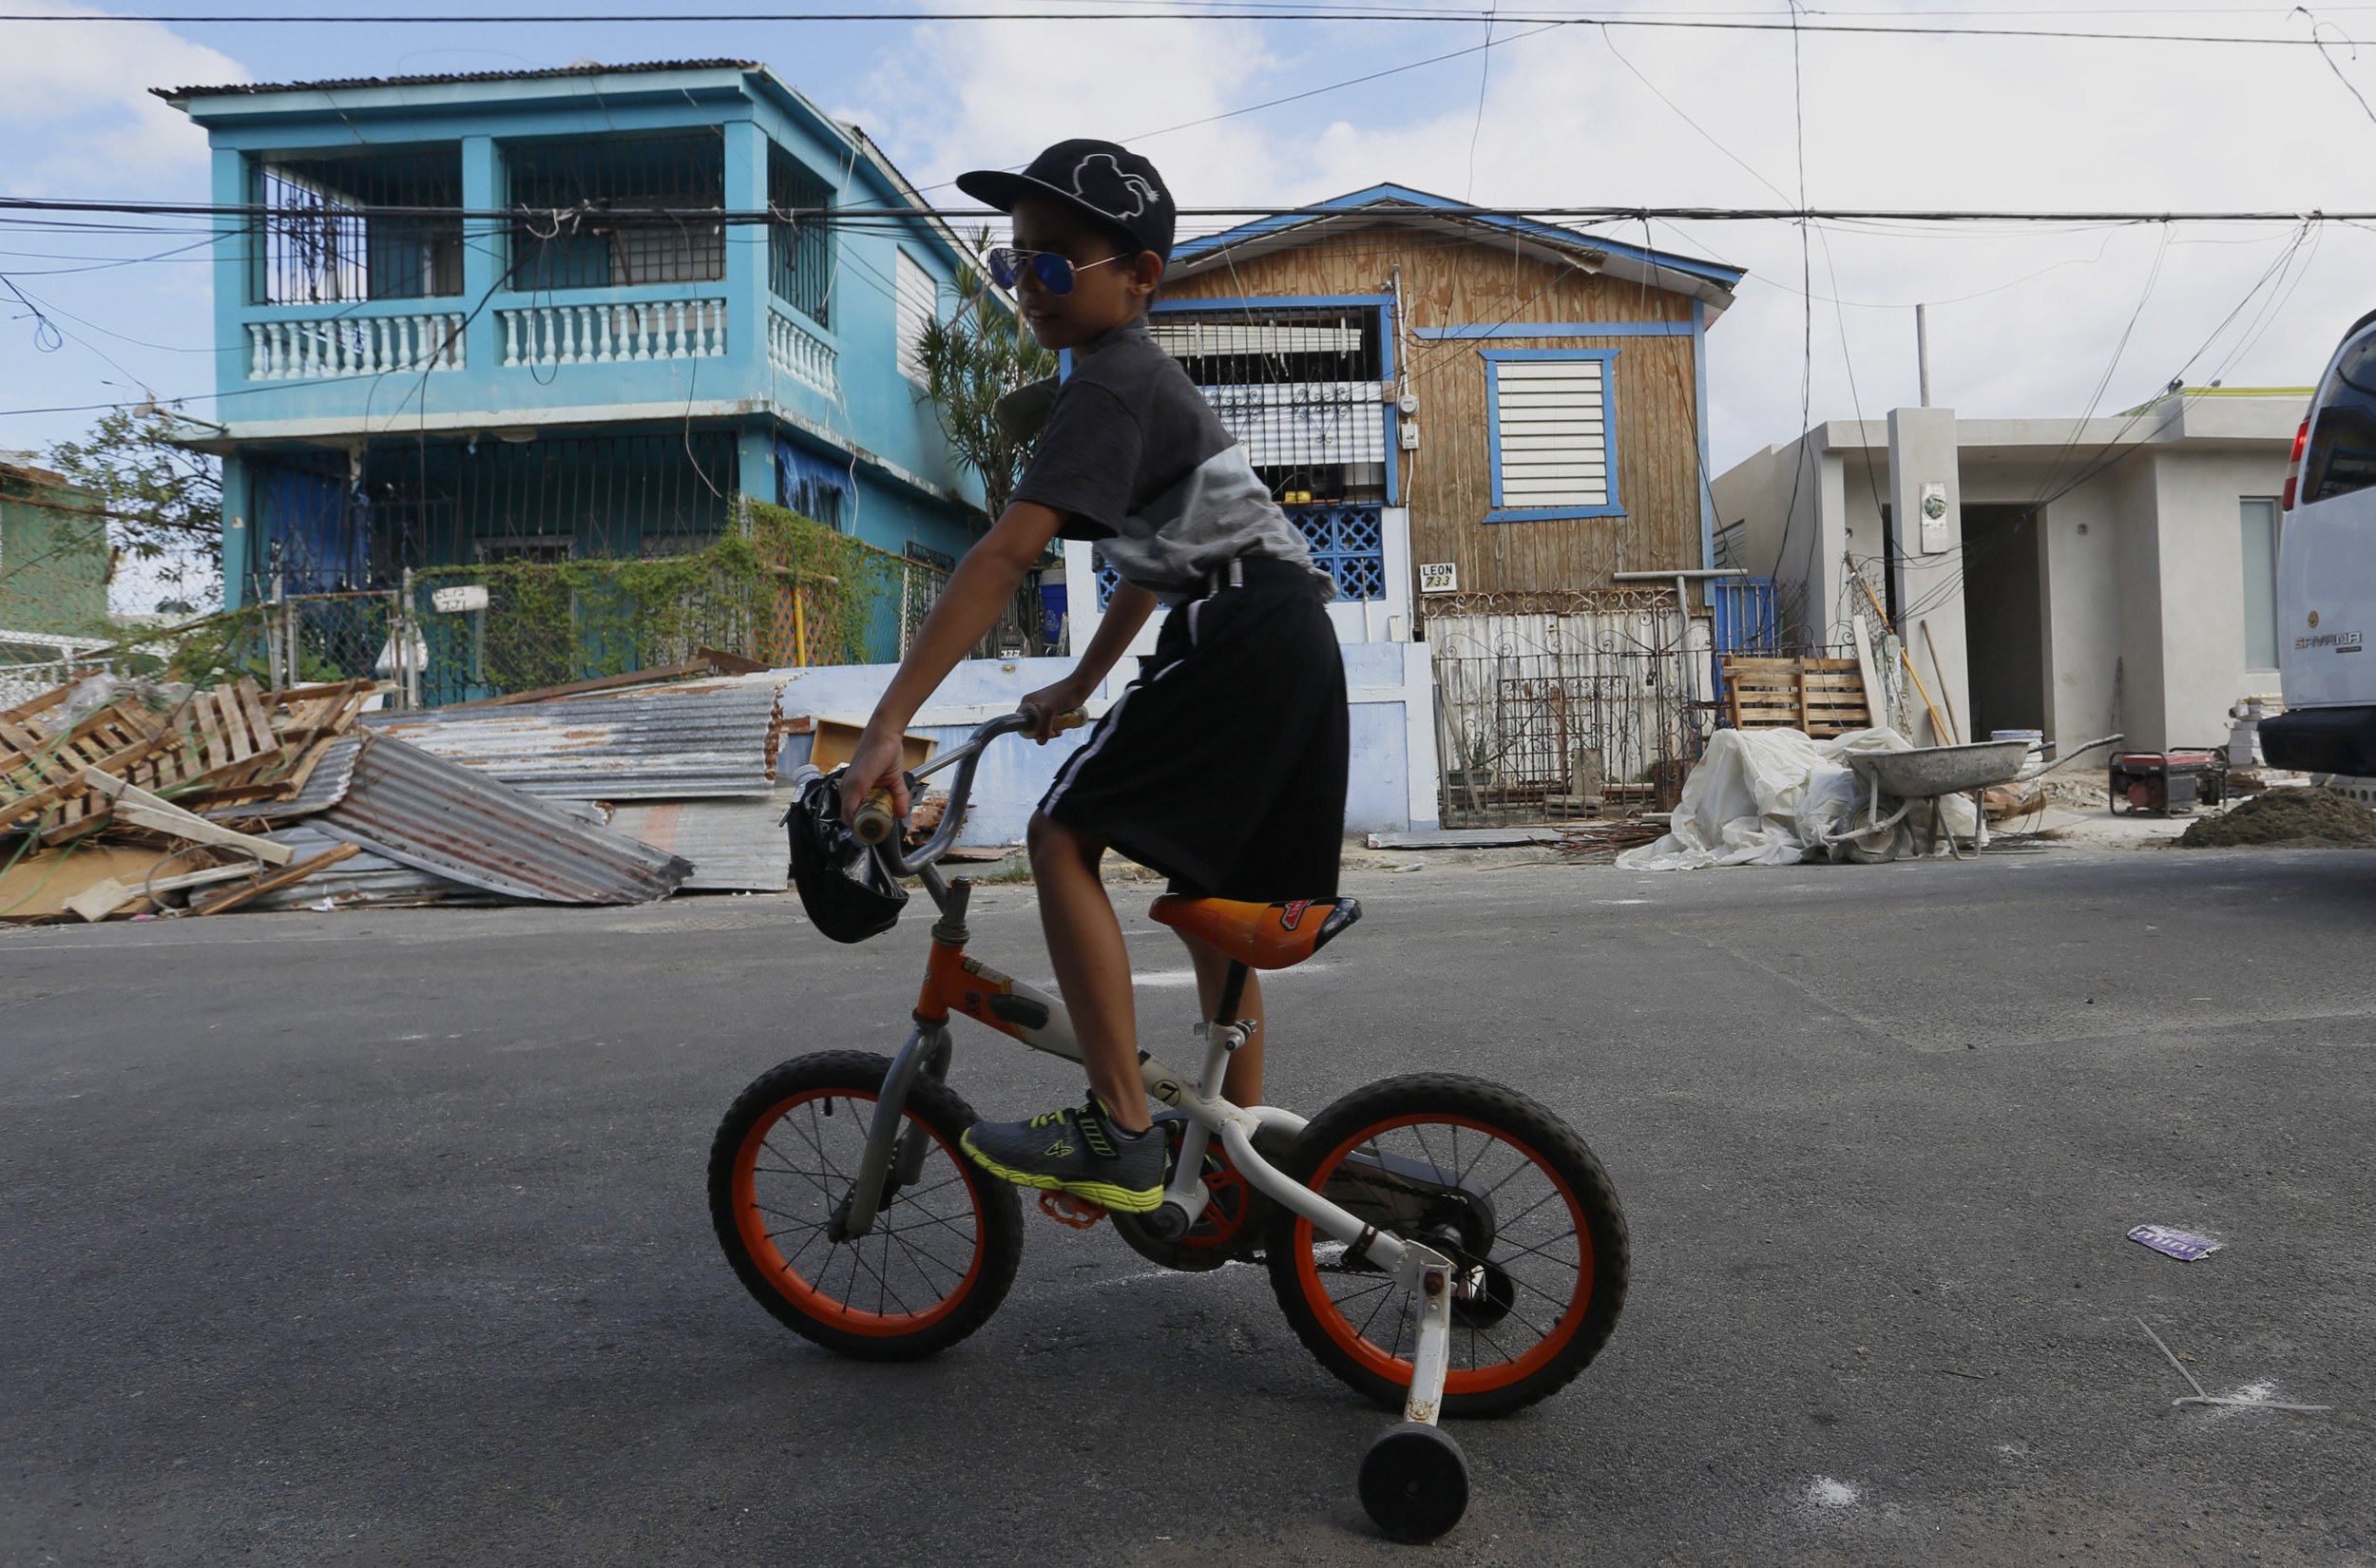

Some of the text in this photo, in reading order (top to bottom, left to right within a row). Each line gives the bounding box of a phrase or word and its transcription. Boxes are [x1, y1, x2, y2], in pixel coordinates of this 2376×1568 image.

[1423, 564, 1452, 576] LEON
[1426, 576, 1450, 587] 733
[1159, 1082, 1178, 1102] 7
